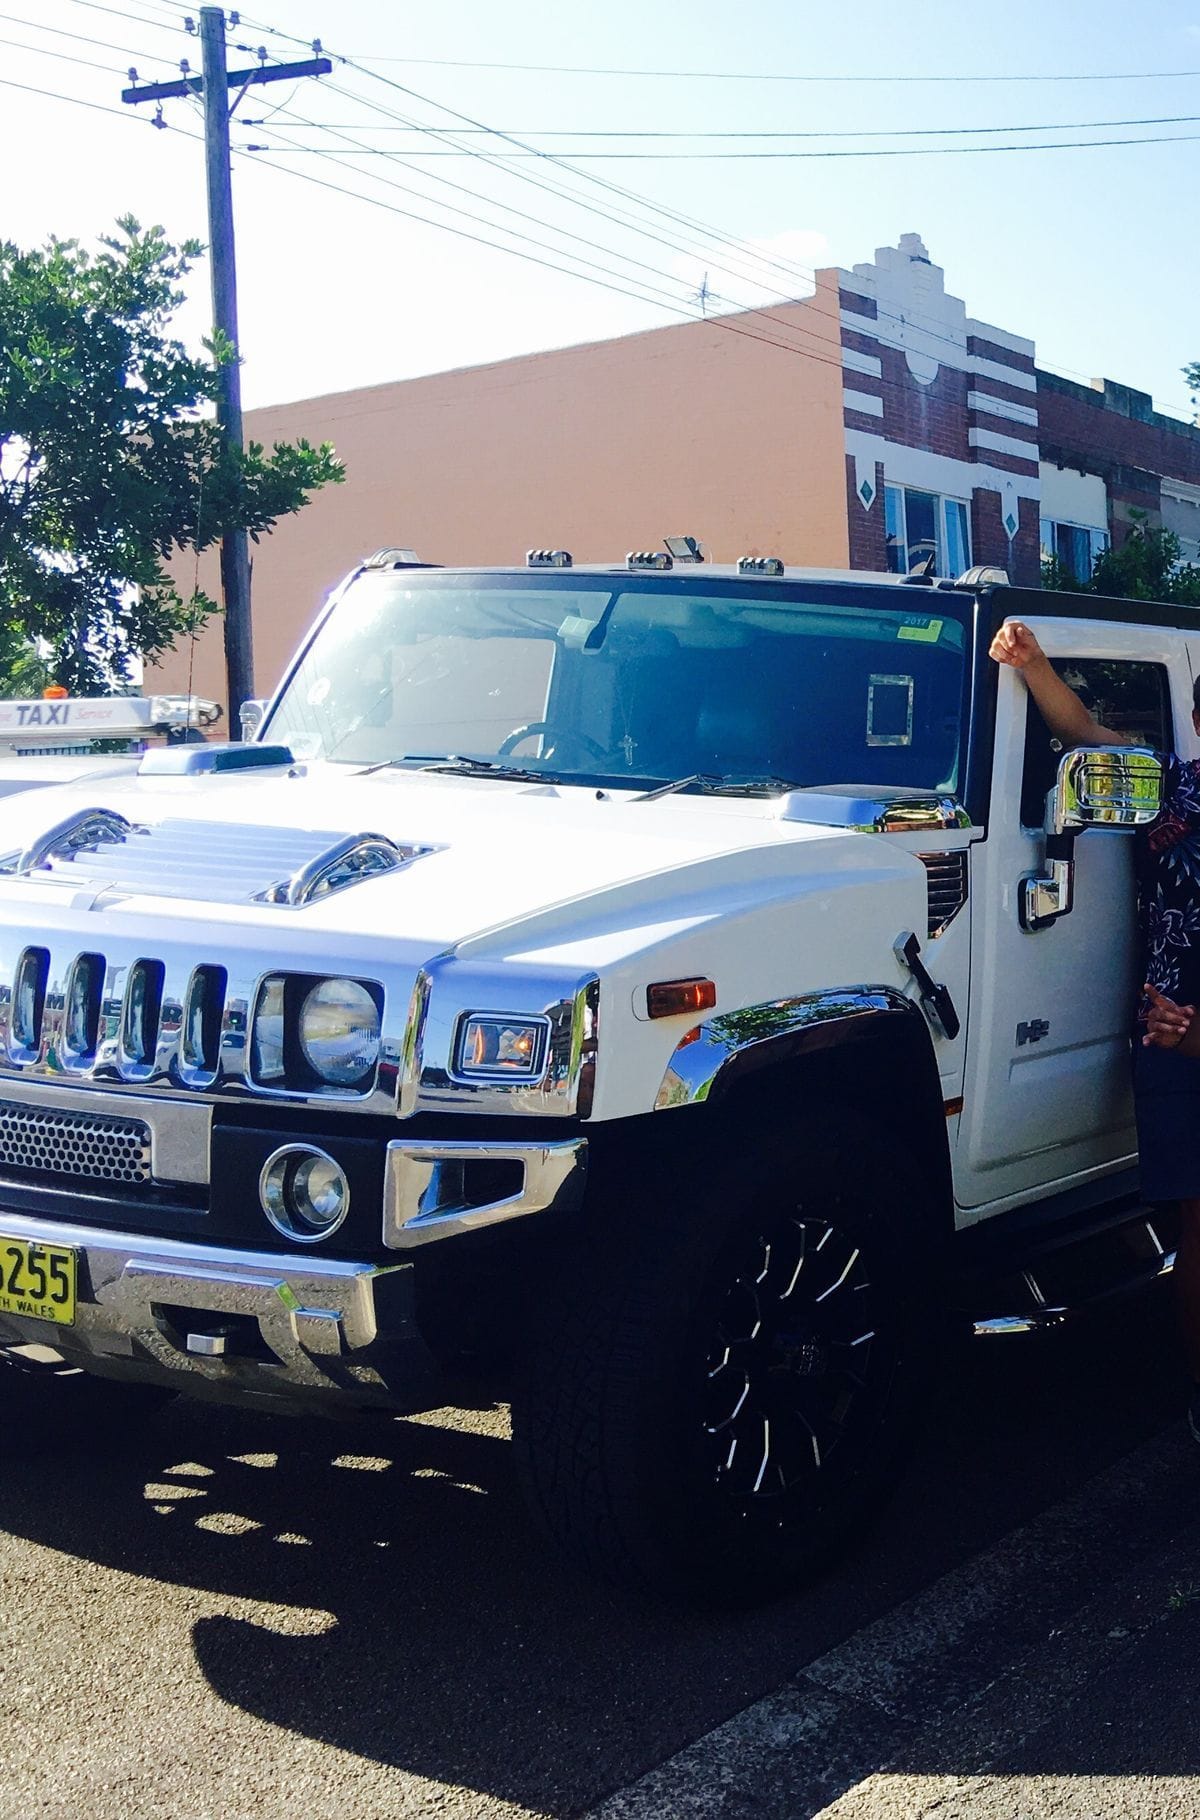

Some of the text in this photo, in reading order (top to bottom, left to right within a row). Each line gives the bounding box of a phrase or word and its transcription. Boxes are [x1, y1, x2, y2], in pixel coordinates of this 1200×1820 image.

[904, 616, 928, 625] 2017
[16, 704, 71, 725] TAXI
[75, 708, 113, 720] Service
[0, 1247, 69, 1304] 255
[16, 1300, 55, 1319] WALES
